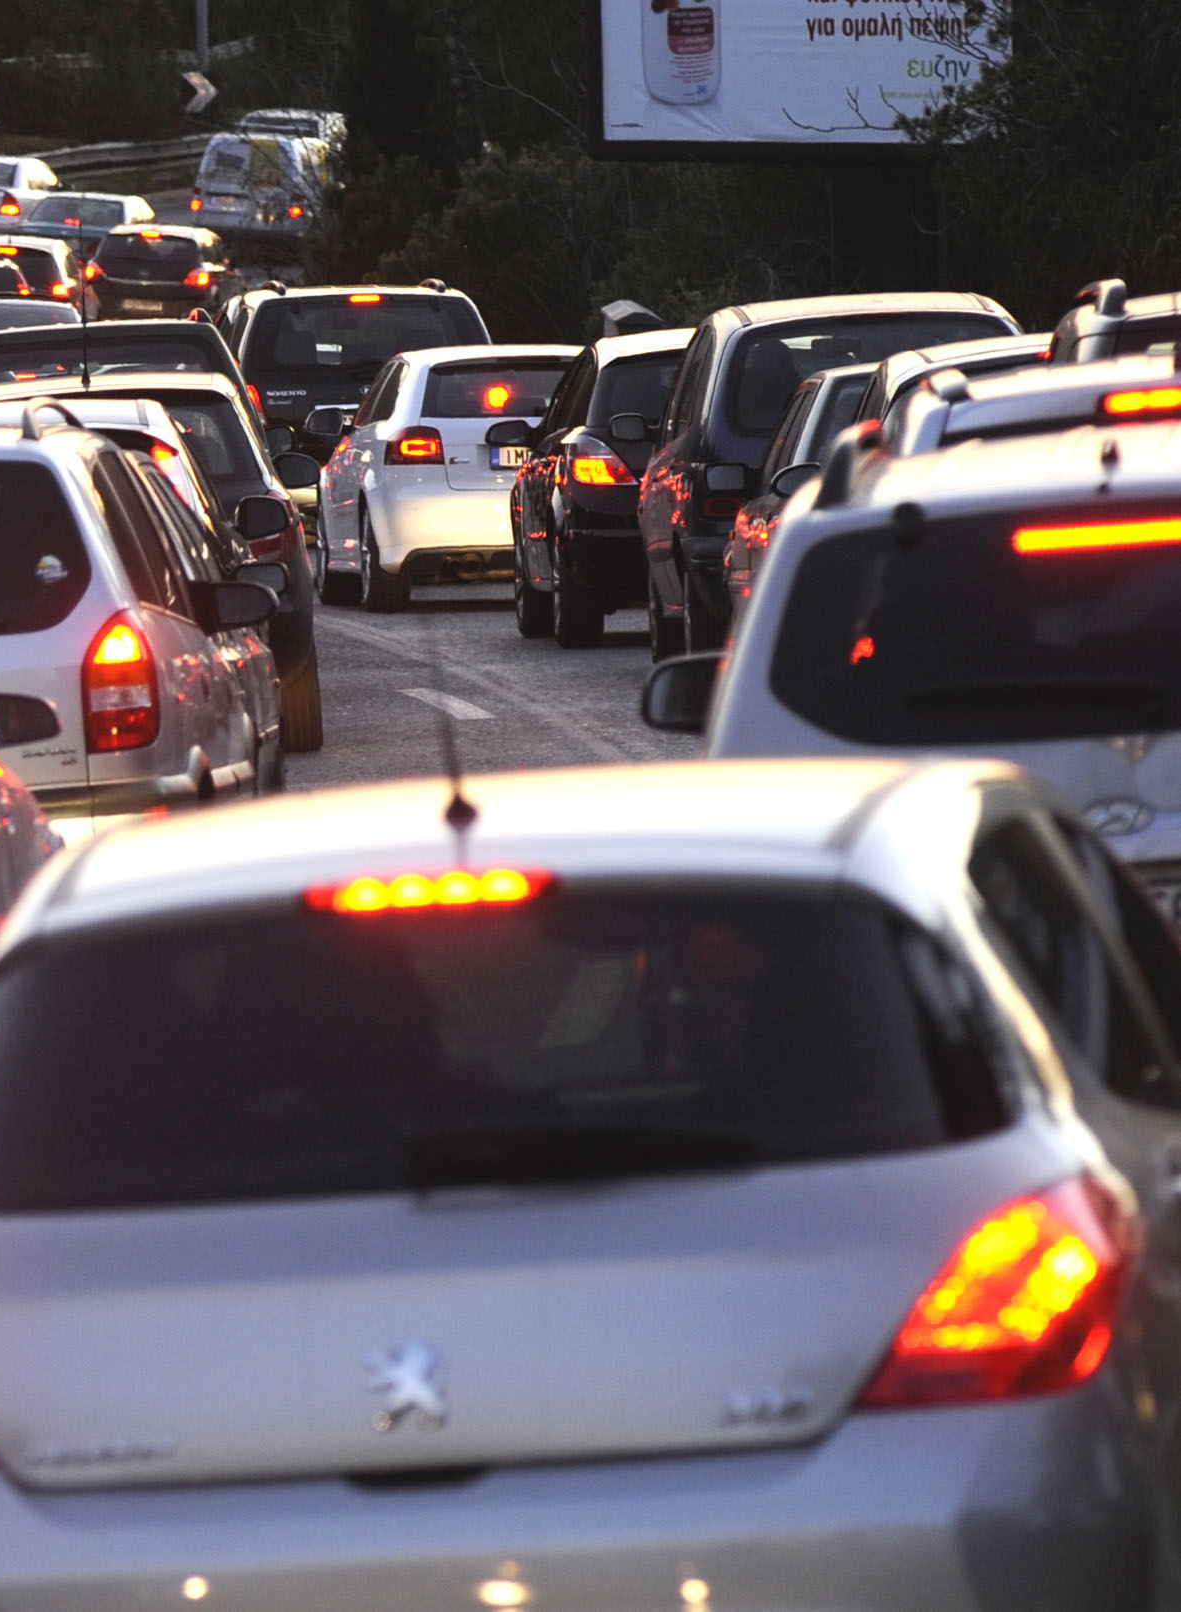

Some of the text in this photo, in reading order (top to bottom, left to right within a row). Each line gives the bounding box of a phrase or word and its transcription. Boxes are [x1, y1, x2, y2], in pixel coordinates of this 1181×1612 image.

[806, 17, 835, 42] για
[841, 12, 903, 42] ομαλή
[907, 54, 971, 83] ευζην
